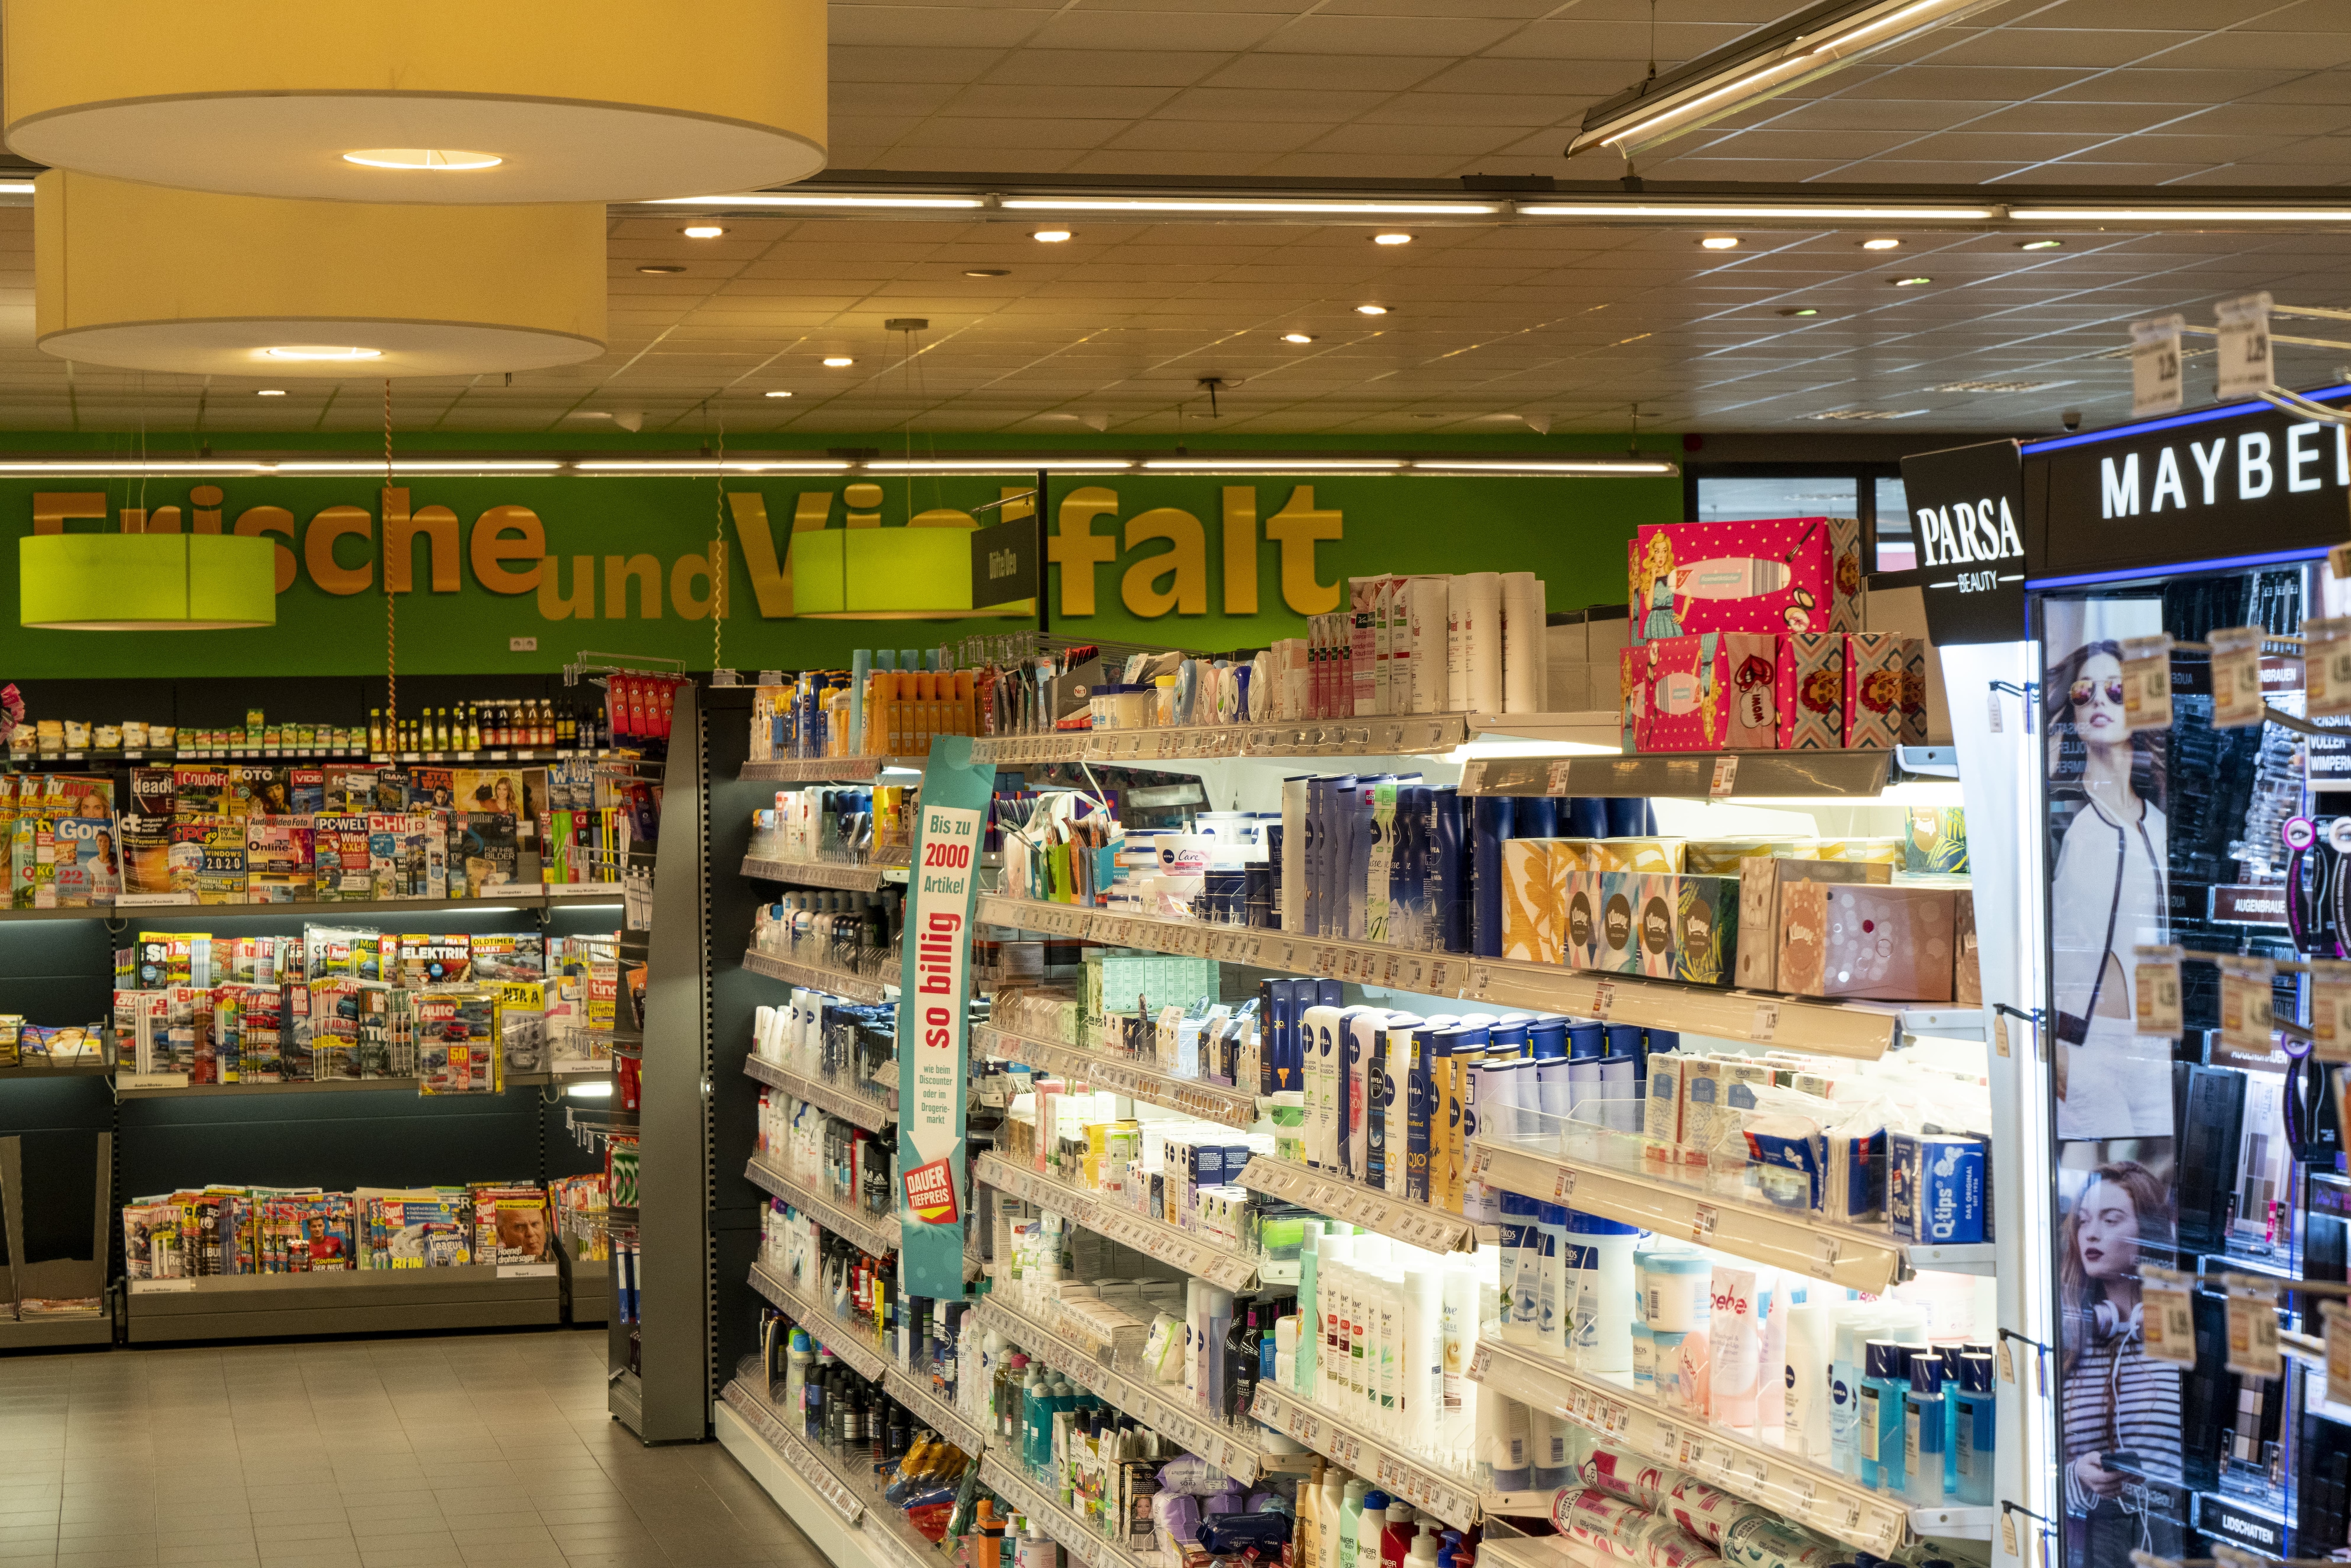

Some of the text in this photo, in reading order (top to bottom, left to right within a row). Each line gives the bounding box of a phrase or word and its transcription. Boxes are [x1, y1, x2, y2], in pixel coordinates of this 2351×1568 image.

[1917, 496, 2024, 566] PARSA
[727, 483, 1343, 618] Vfalt
[537, 541, 729, 621] und
[1957, 570, 1997, 593] BEAUTY
[2259, 666, 2296, 682] NBRAUEN
[233, 770, 273, 781] FOTO
[63, 782, 94, 798] pur
[251, 817, 271, 827] Audio
[272, 818, 292, 826] Video
[930, 814, 971, 835] Bis zu
[183, 827, 210, 842] PC
[249, 841, 293, 852] Online-
[924, 843, 970, 869] 2000
[1178, 849, 1200, 861] Care
[59, 870, 83, 884] 22
[924, 876, 964, 894] Artikel
[2234, 898, 2286, 913] AUGENBRAUE
[402, 947, 469, 959] ELEKTRIK
[919, 912, 961, 1049] so billig
[292, 987, 306, 1001] Auto
[292, 1000, 308, 1012] Bild
[422, 1005, 455, 1017] Auto
[450, 1050, 468, 1060] 50
[923, 1064, 951, 1075] wie beim
[920, 1074, 952, 1086] Discounter
[923, 1090, 946, 1099] oder im
[921, 1102, 950, 1112] Drogerie-
[927, 1115, 945, 1125] markt
[907, 1165, 945, 1193] DAUER
[910, 1187, 949, 1206] TIEFPREIS
[385, 1205, 403, 1216] Sport
[476, 1204, 495, 1216] Sport
[393, 1214, 403, 1225] Bild
[1500, 1228, 1515, 1237] elkos
[431, 1240, 464, 1252] League
[498, 1246, 522, 1256] Hoeneß
[498, 1254, 521, 1264] drohte
[1099, 1441, 1109, 1455] Bioré
[2222, 1514, 2273, 1544] LIDSCHATTEN
